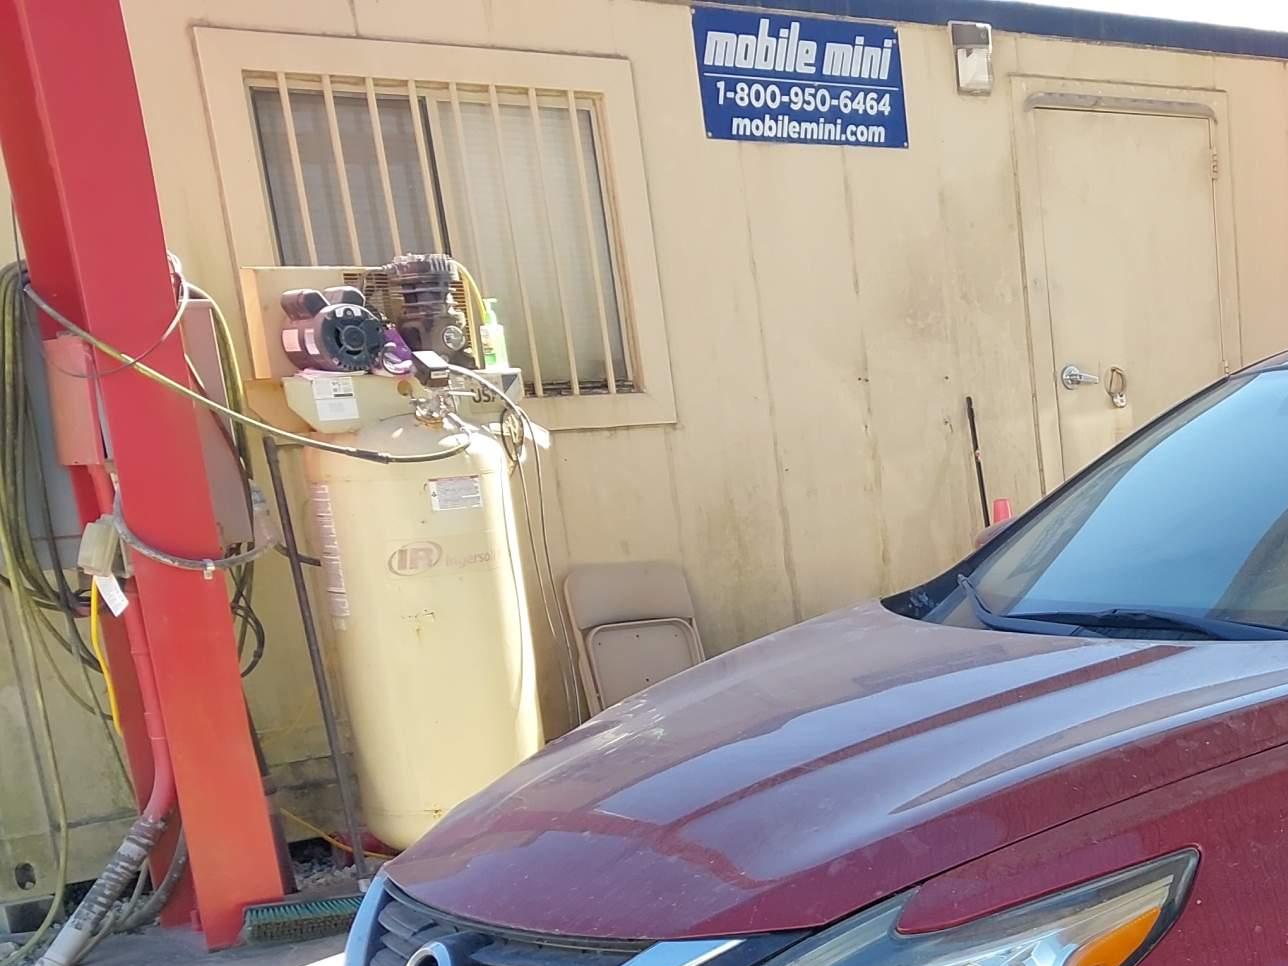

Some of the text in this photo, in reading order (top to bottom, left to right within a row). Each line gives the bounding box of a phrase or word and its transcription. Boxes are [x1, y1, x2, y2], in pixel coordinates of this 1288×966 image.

[704, 18, 893, 80] mobile mini
[716, 80, 891, 116] 1-800-950-6464
[731, 114, 885, 143] mobilemini.com
